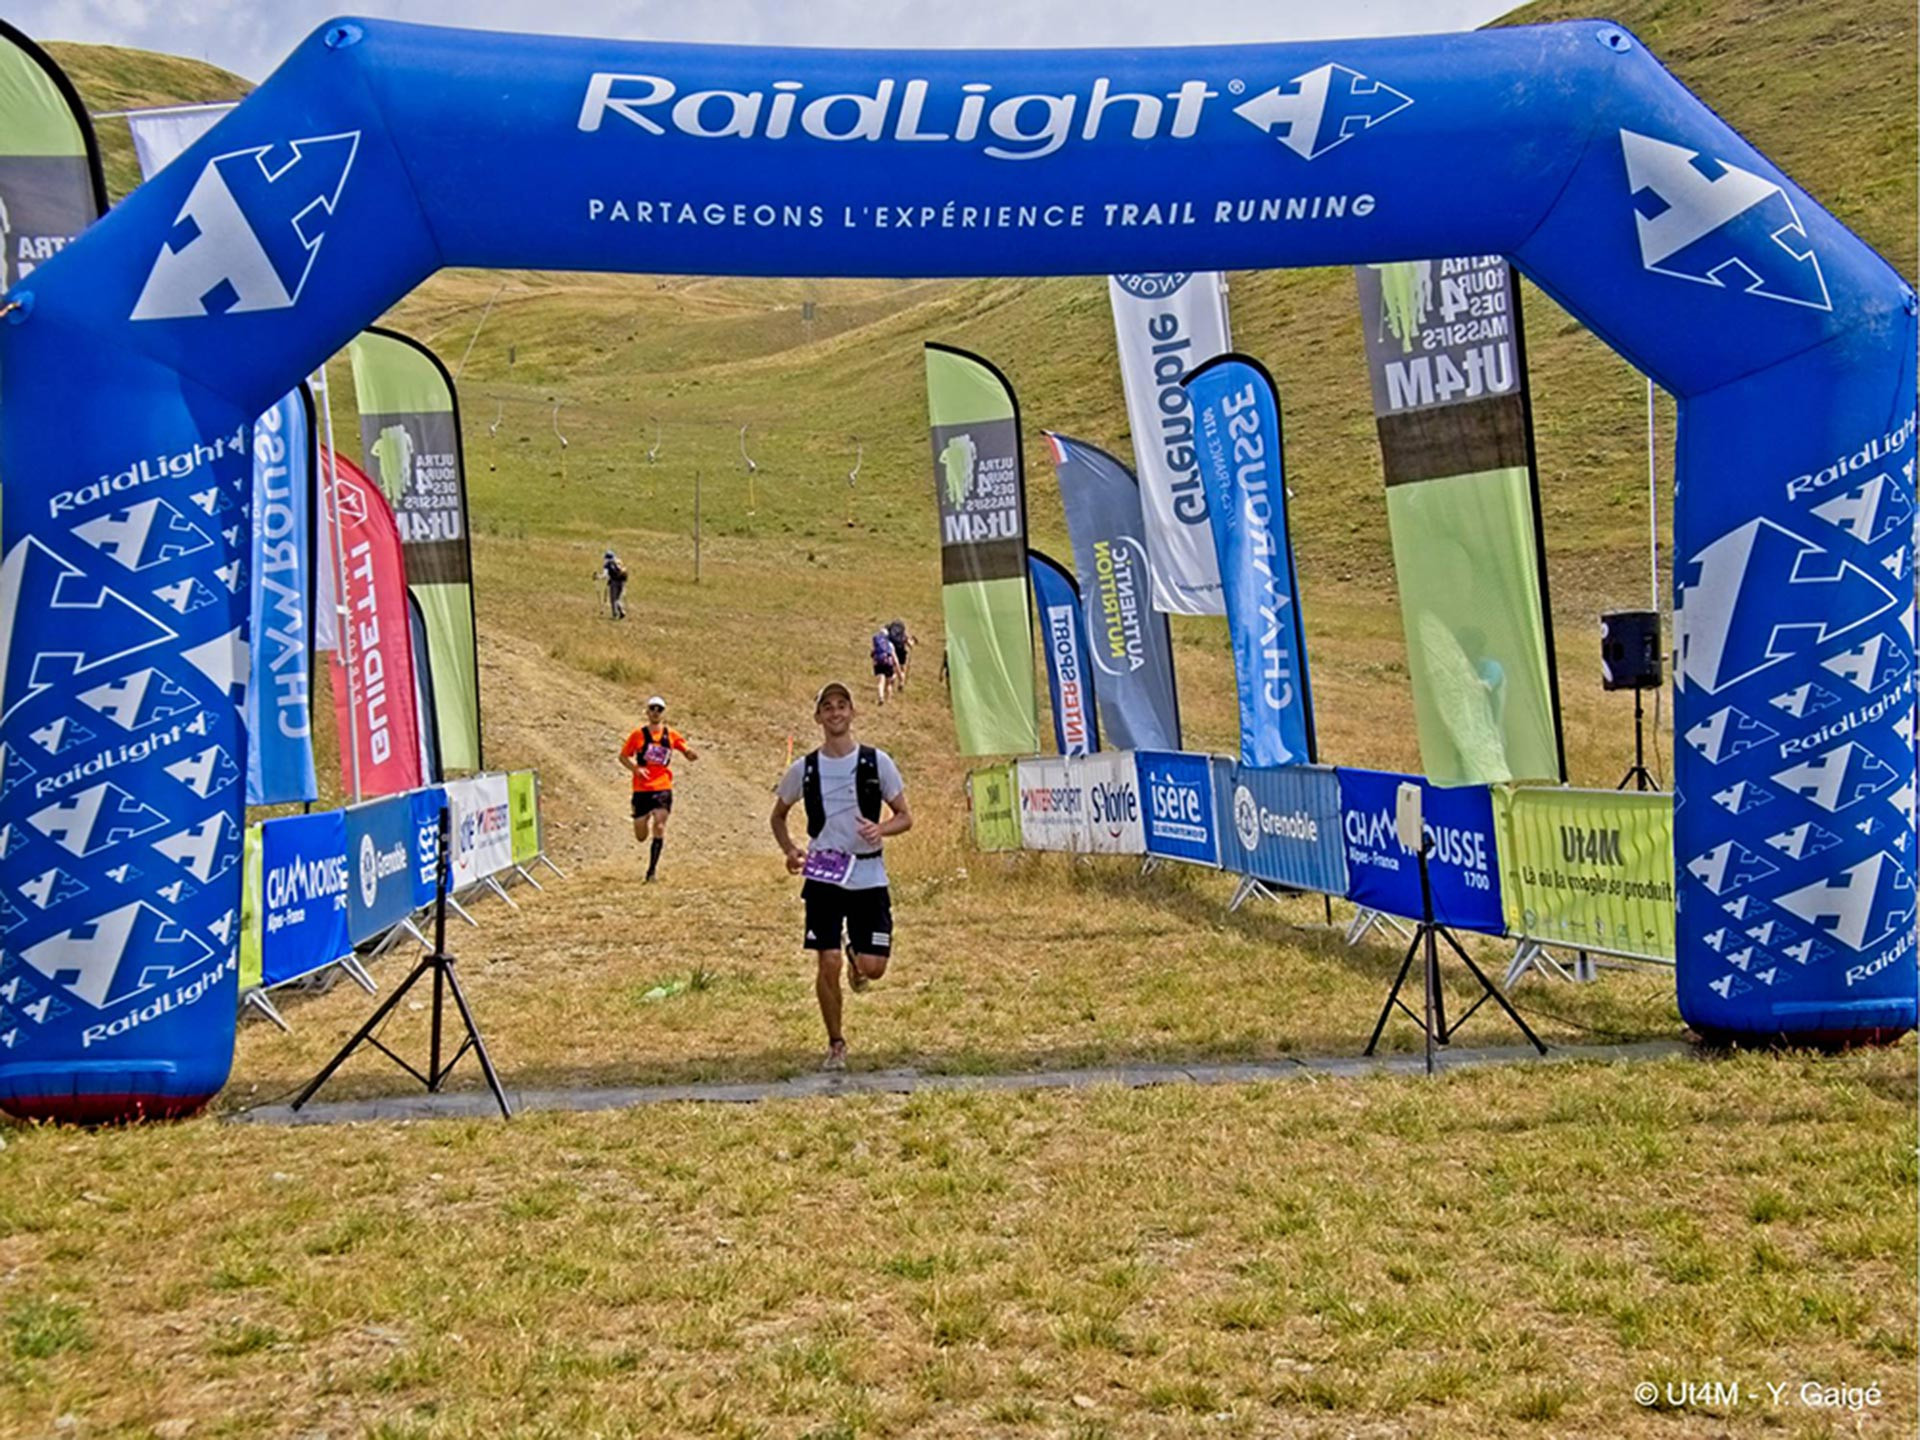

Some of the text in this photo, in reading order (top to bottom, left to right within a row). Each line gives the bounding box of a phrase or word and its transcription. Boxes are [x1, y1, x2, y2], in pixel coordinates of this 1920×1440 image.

[589, 194, 1376, 228] PARTAGEONS L'EXPÉRIENCE TRAIL RUNNING
[50, 437, 225, 519] RaidLight
[1779, 686, 1902, 759] RaidLight
[35, 725, 181, 799] RaidLight
[1260, 807, 1318, 842] Grenoble
[1345, 807, 1488, 871] CHAMOUSSE
[1560, 825, 1624, 867] Ut4M
[1463, 871, 1490, 890] 1700
[1608, 878, 1622, 896] se
[1624, 880, 1673, 902] produit
[82, 963, 224, 1048] RaidLight
